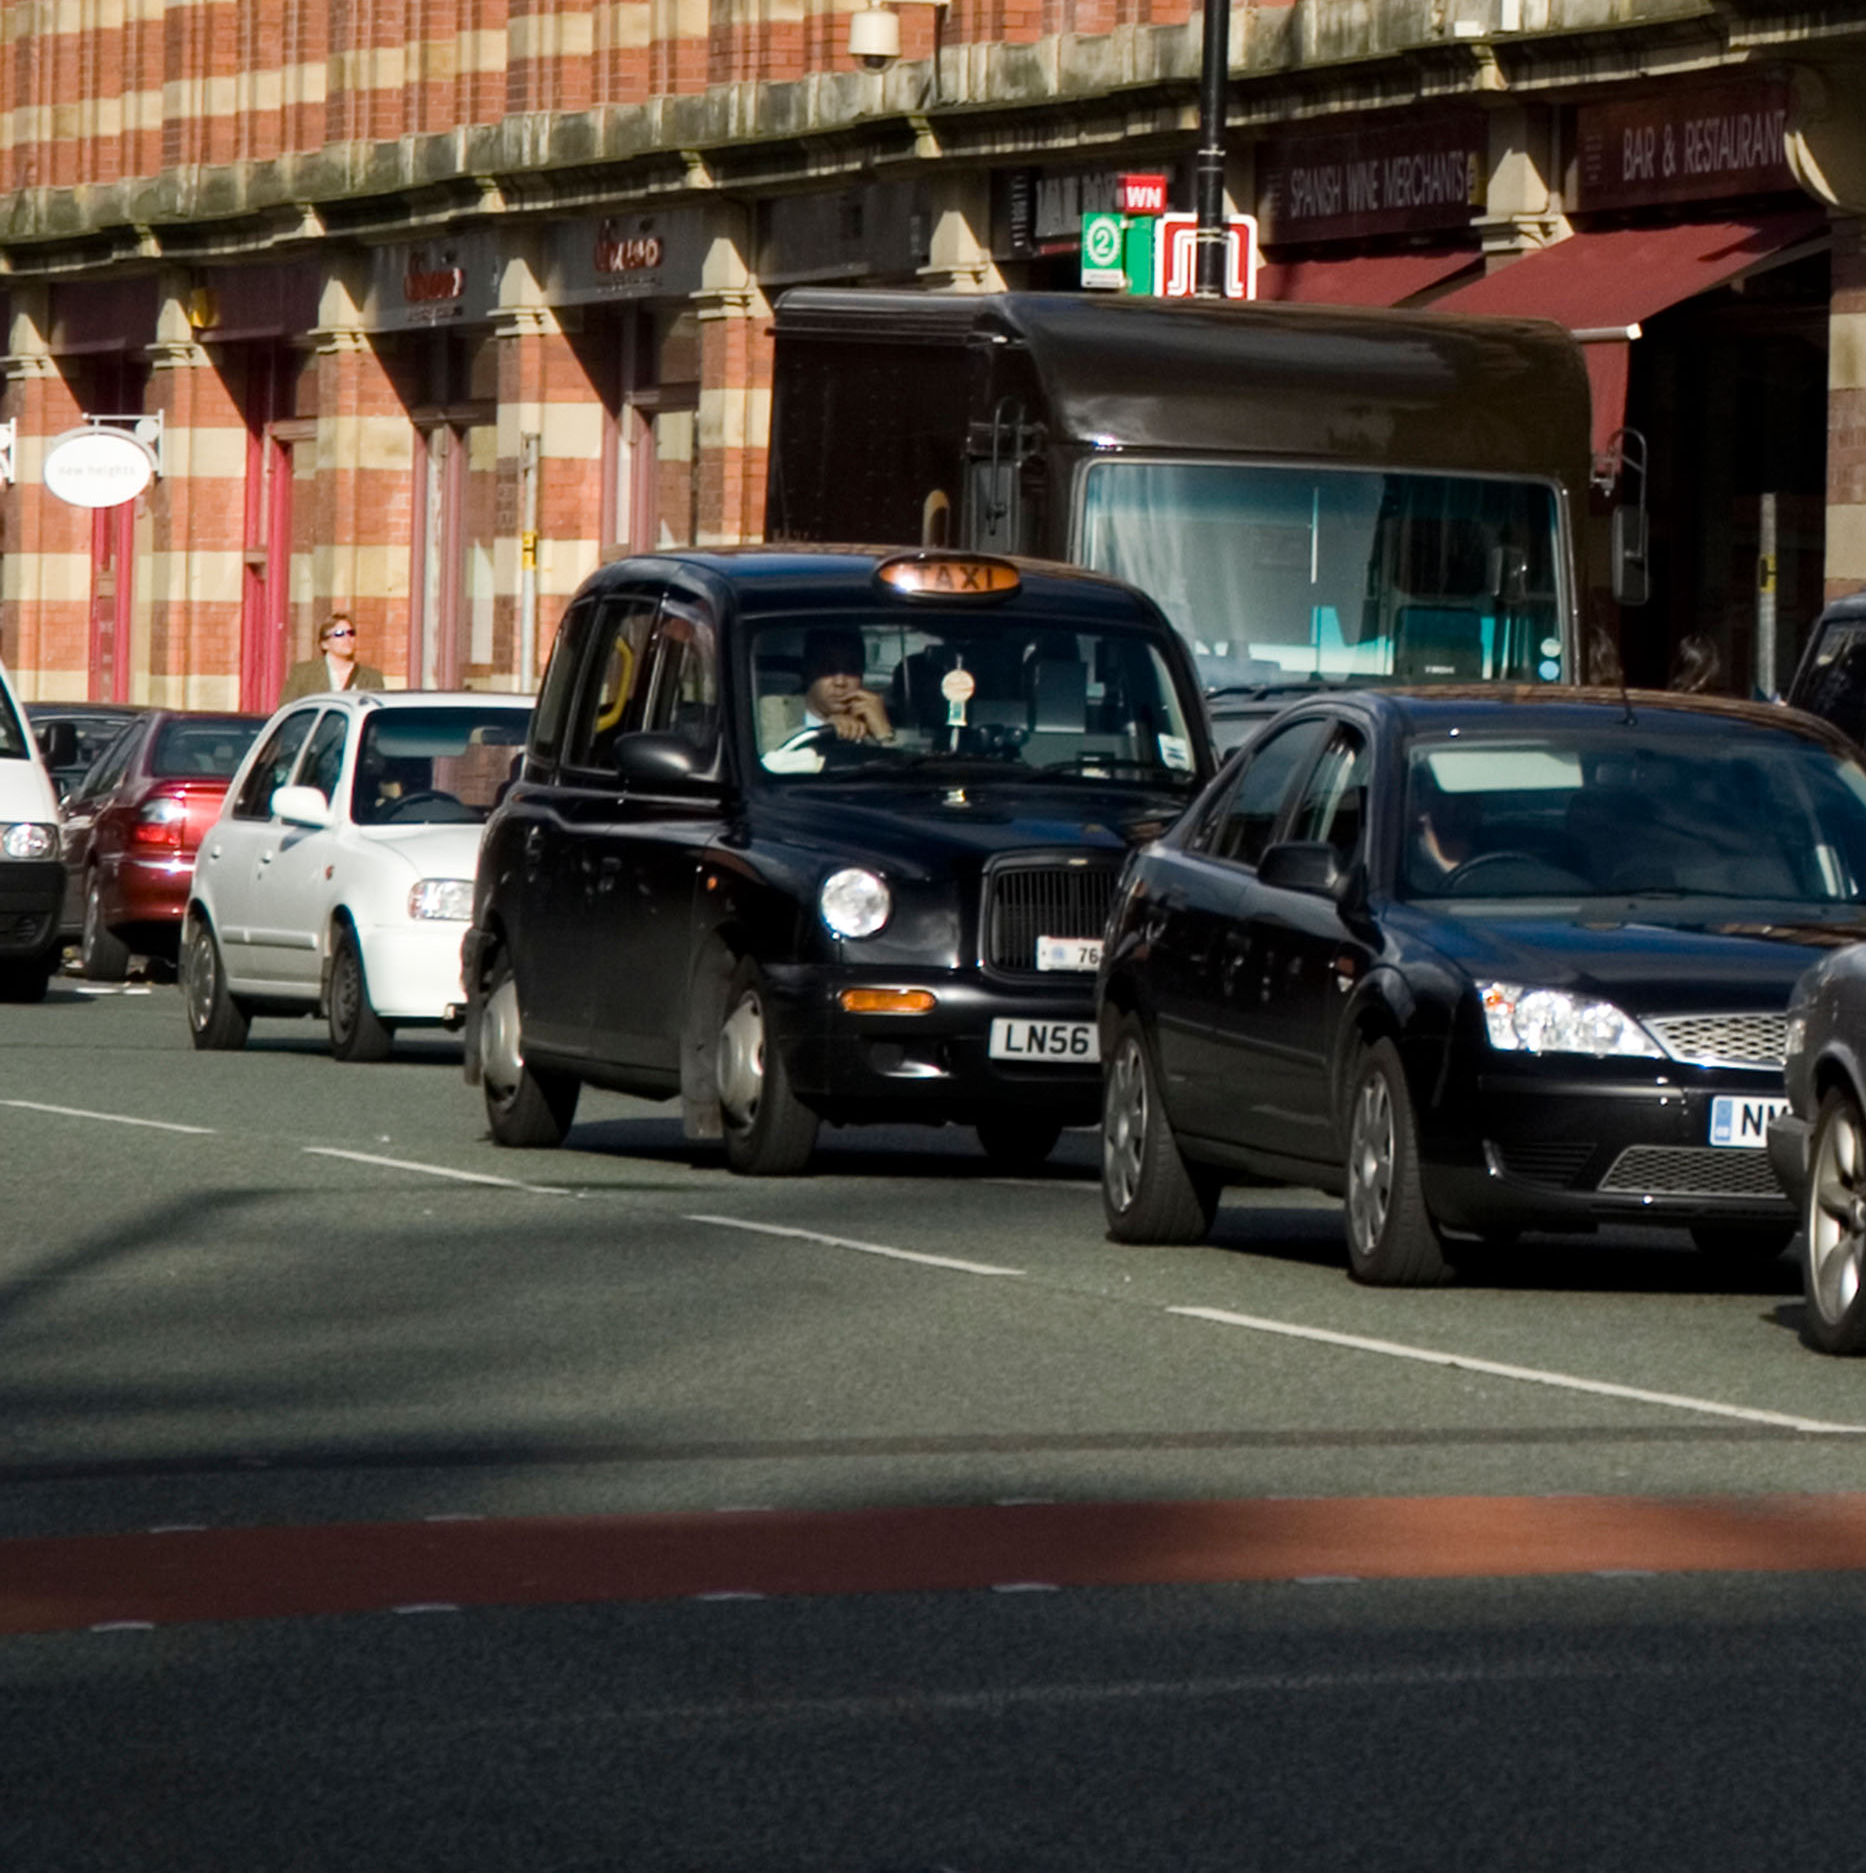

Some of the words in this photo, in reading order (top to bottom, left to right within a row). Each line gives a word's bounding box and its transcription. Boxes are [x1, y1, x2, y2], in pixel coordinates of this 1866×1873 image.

[1622, 125, 1657, 182] BAR
[1662, 123, 1677, 177] &
[1683, 109, 1787, 175] RESTAURANT
[1289, 167, 1342, 220] SPANISH
[1346, 159, 1379, 213] WINE
[1383, 148, 1465, 209] MERCHANTS
[1095, 229, 1110, 255] 2
[914, 564, 993, 591] TAXI
[1005, 1023, 1090, 1055] LN56
